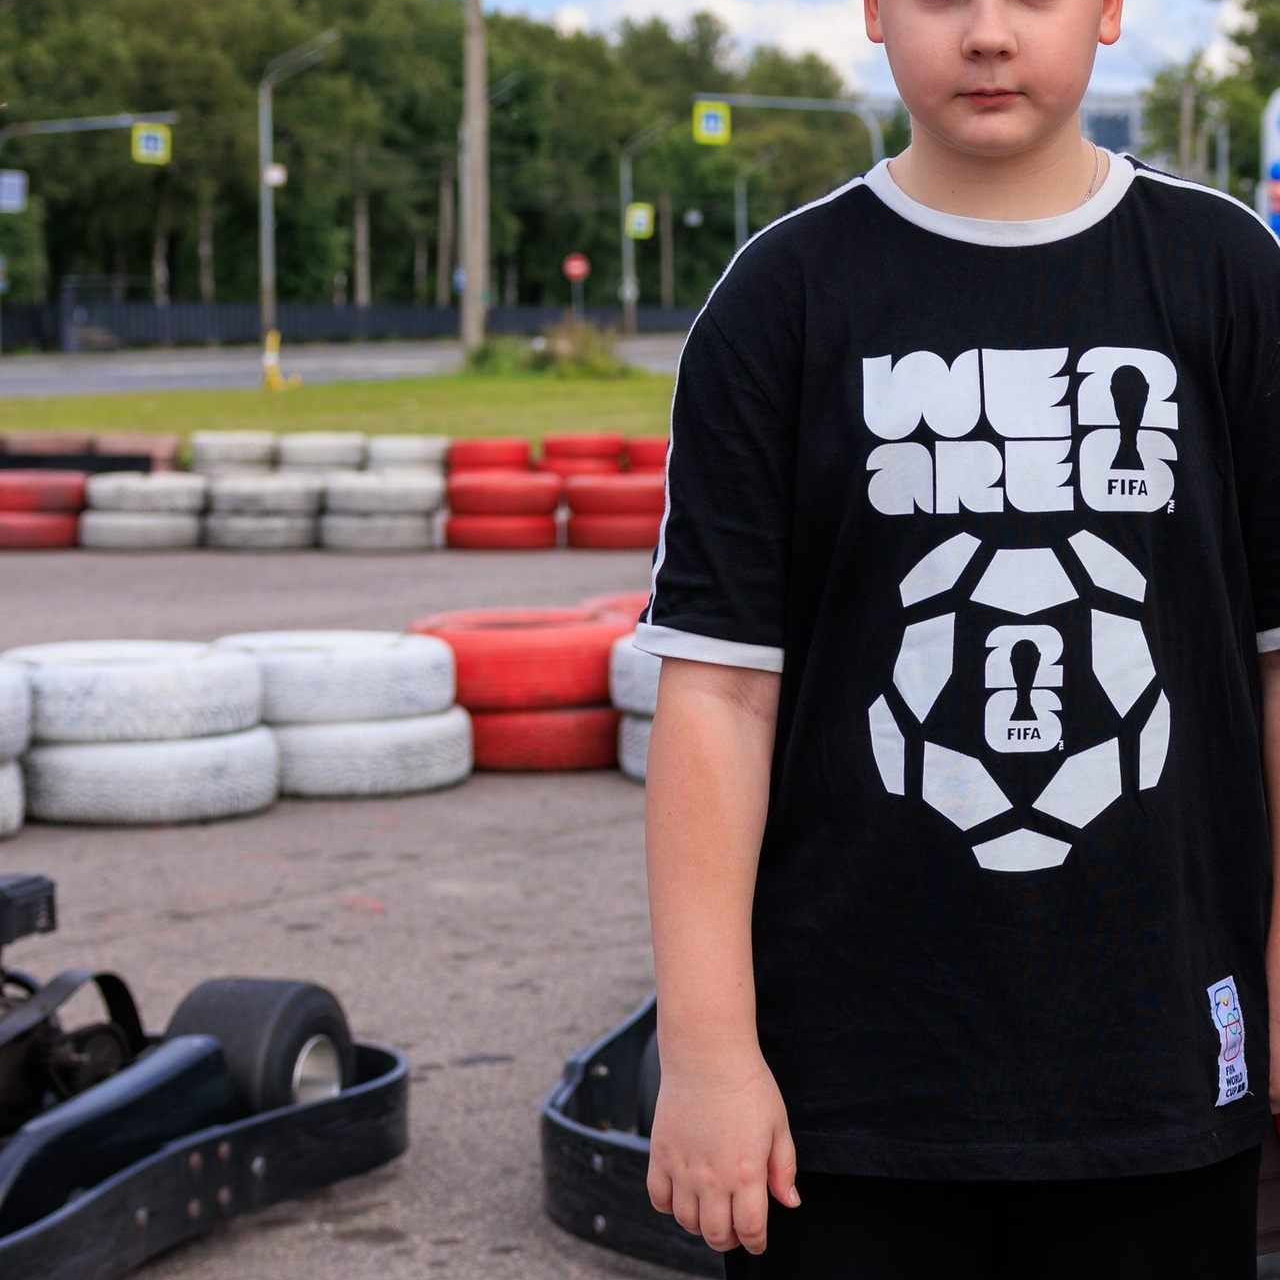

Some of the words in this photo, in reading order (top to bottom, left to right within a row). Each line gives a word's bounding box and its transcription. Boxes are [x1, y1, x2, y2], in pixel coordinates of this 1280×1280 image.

[863, 347, 1072, 440] WE
[1107, 479, 1148, 496] FIFA
[1007, 727, 1041, 740] FIFA
[1225, 1064, 1236, 1076] FIFA
[1226, 1072, 1243, 1087] WORLD
[1225, 1086, 1238, 1098] CUP
